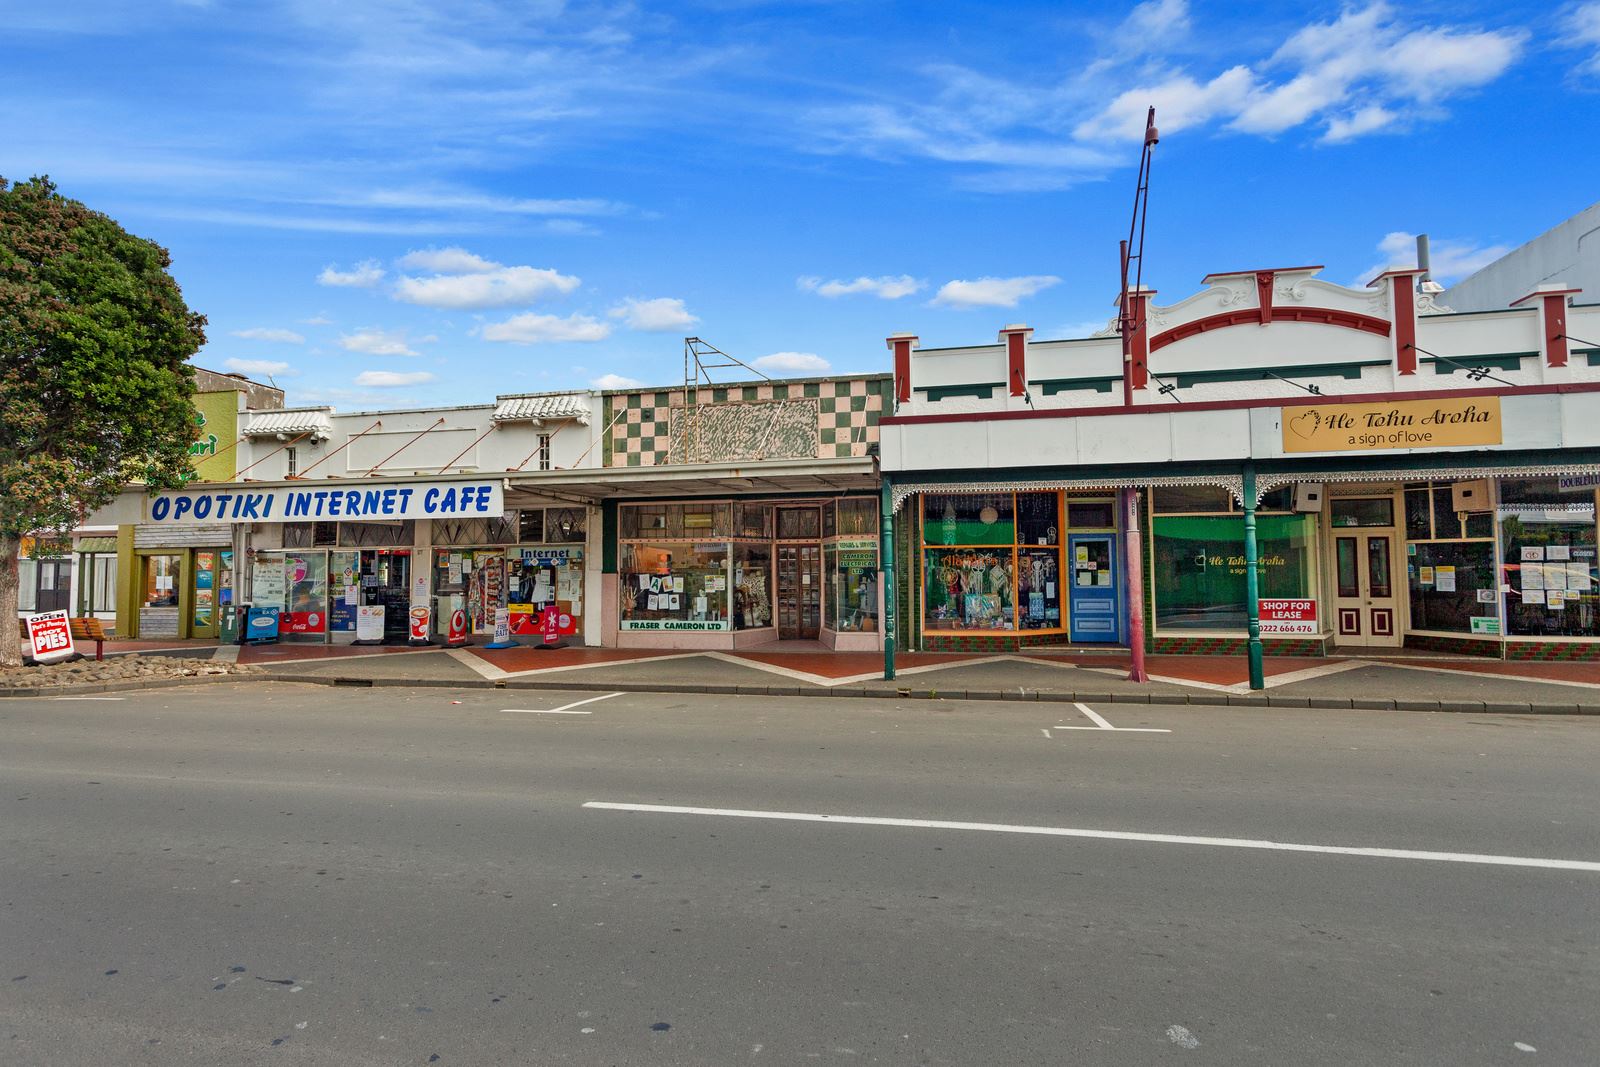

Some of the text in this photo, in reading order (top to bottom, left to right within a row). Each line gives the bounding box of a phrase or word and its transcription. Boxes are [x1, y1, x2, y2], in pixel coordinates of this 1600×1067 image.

[1325, 405, 1493, 430] He Tohu Aroha
[1348, 430, 1433, 447] a sign of love
[151, 485, 492, 521] OPOTIKI INTERNET CAFE
[520, 548, 570, 558] Internet
[1262, 602, 1311, 610] SHOP FOR
[30, 613, 64, 622] OPEN
[1272, 611, 1302, 619] LEASE
[629, 622, 722, 630] FRASER CAMERON LTD
[1280, 624, 1295, 633] 666
[1297, 624, 1312, 633] 476
[37, 627, 62, 637] HOT
[35, 632, 68, 651] PIES
